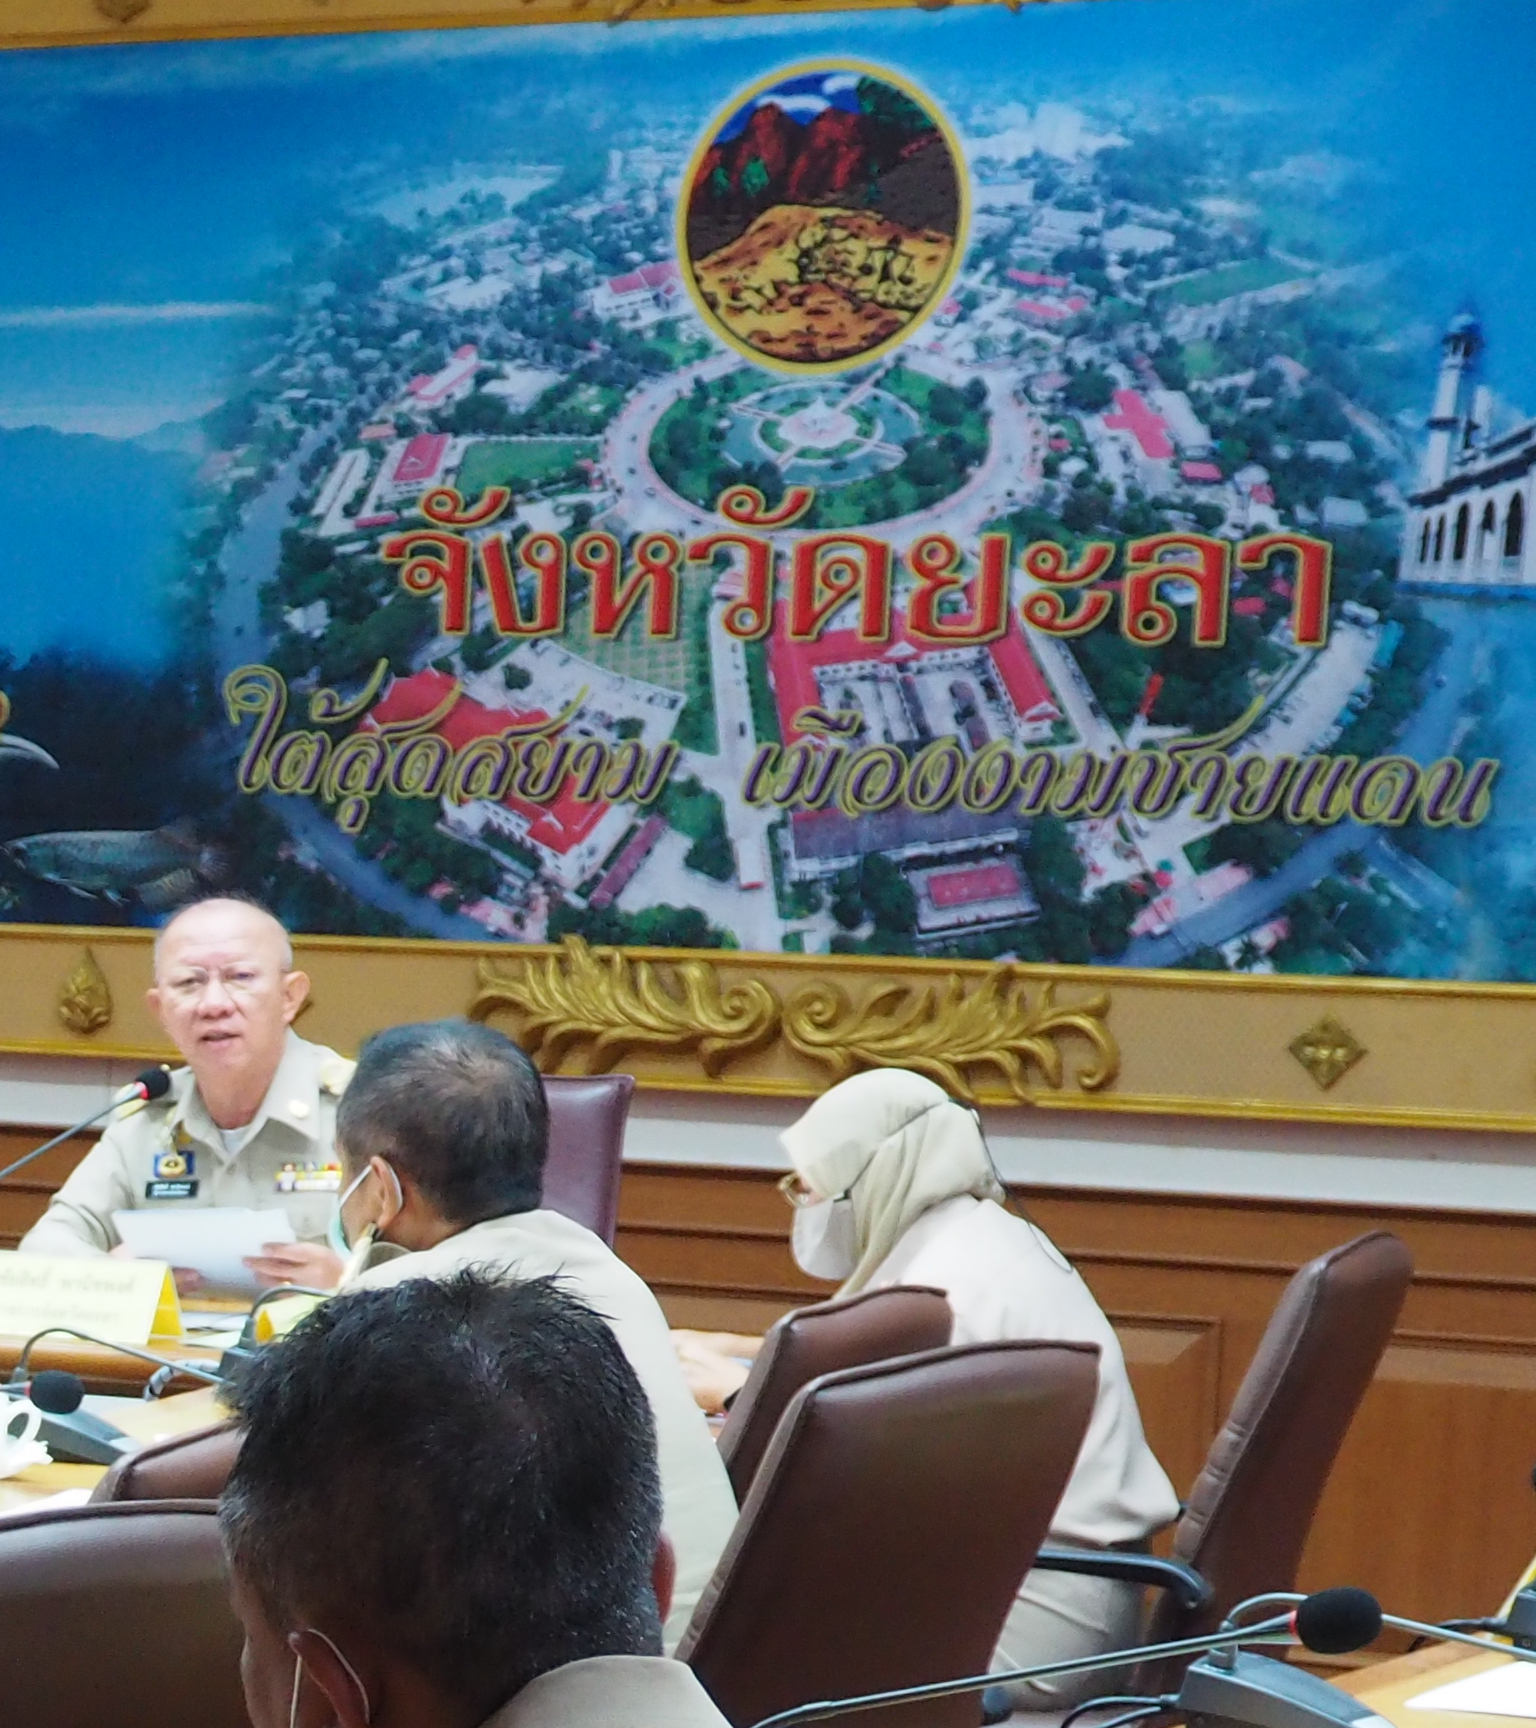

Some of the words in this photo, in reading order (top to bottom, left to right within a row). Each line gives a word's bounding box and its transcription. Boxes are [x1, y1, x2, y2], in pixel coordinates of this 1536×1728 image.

[383, 484, 1334, 650] จังหวัดยะลา
[223, 660, 679, 832] ใต้สุดสยาม
[740, 697, 1499, 830] เมืองงามชายแดน
